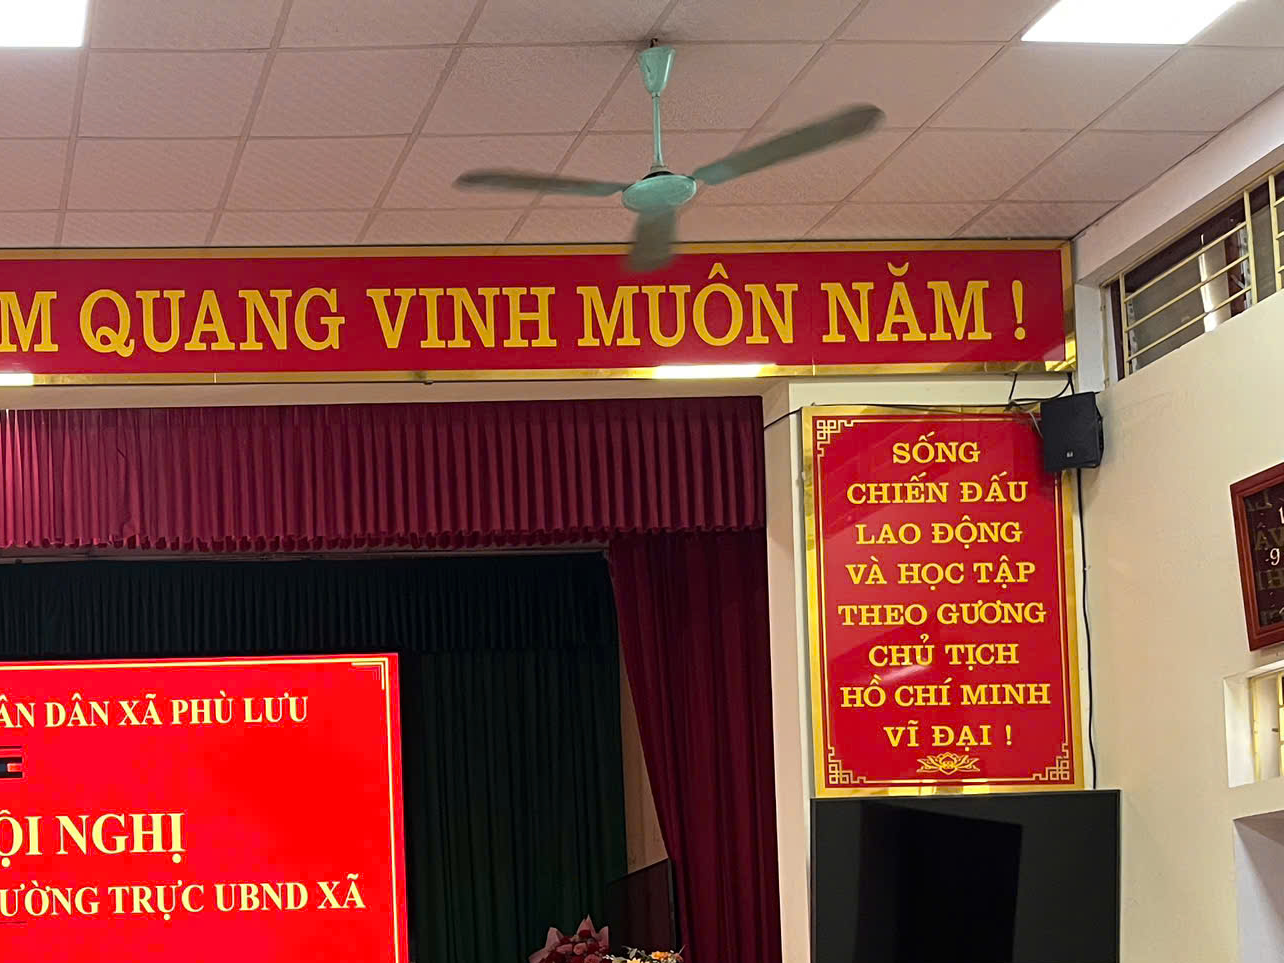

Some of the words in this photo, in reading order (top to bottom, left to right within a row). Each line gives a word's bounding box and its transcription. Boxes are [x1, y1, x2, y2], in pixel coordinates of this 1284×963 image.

[79, 287, 346, 357] QUANG
[366, 287, 557, 349] VINH
[576, 262, 799, 348] MUÔN
[820, 262, 992, 343] NĂM
[1012, 280, 1026, 341] !
[892, 431, 981, 464] SỐNG
[846, 471, 949, 505] CHIẾN
[959, 471, 1029, 503] ĐẤU
[854, 522, 922, 545] LAO
[931, 514, 1023, 550] ĐỘNG
[845, 555, 888, 585] VÀ
[897, 562, 965, 591] HỌC
[972, 554, 1036, 589] TẬP
[837, 603, 928, 626] THEO
[936, 599, 1047, 625] GƯƠNG
[868, 633, 935, 668] CHỦ
[944, 643, 1020, 671] TỊCH
[839, 673, 886, 708] HỒ
[894, 677, 953, 707] CHÍ
[959, 683, 1051, 706] MINH
[44, 692, 110, 728] DÂN
[118, 693, 163, 726] XÃ
[171, 690, 234, 725] PHÙ
[243, 692, 308, 723] LƯU
[883, 719, 920, 748] VĨ
[931, 724, 992, 752] ĐẠI
[1005, 724, 1013, 746] !
[55, 812, 185, 864] NGHỊ
[107, 879, 204, 921] TRỰC
[214, 882, 309, 912] UBND
[317, 873, 366, 909] XÃ
